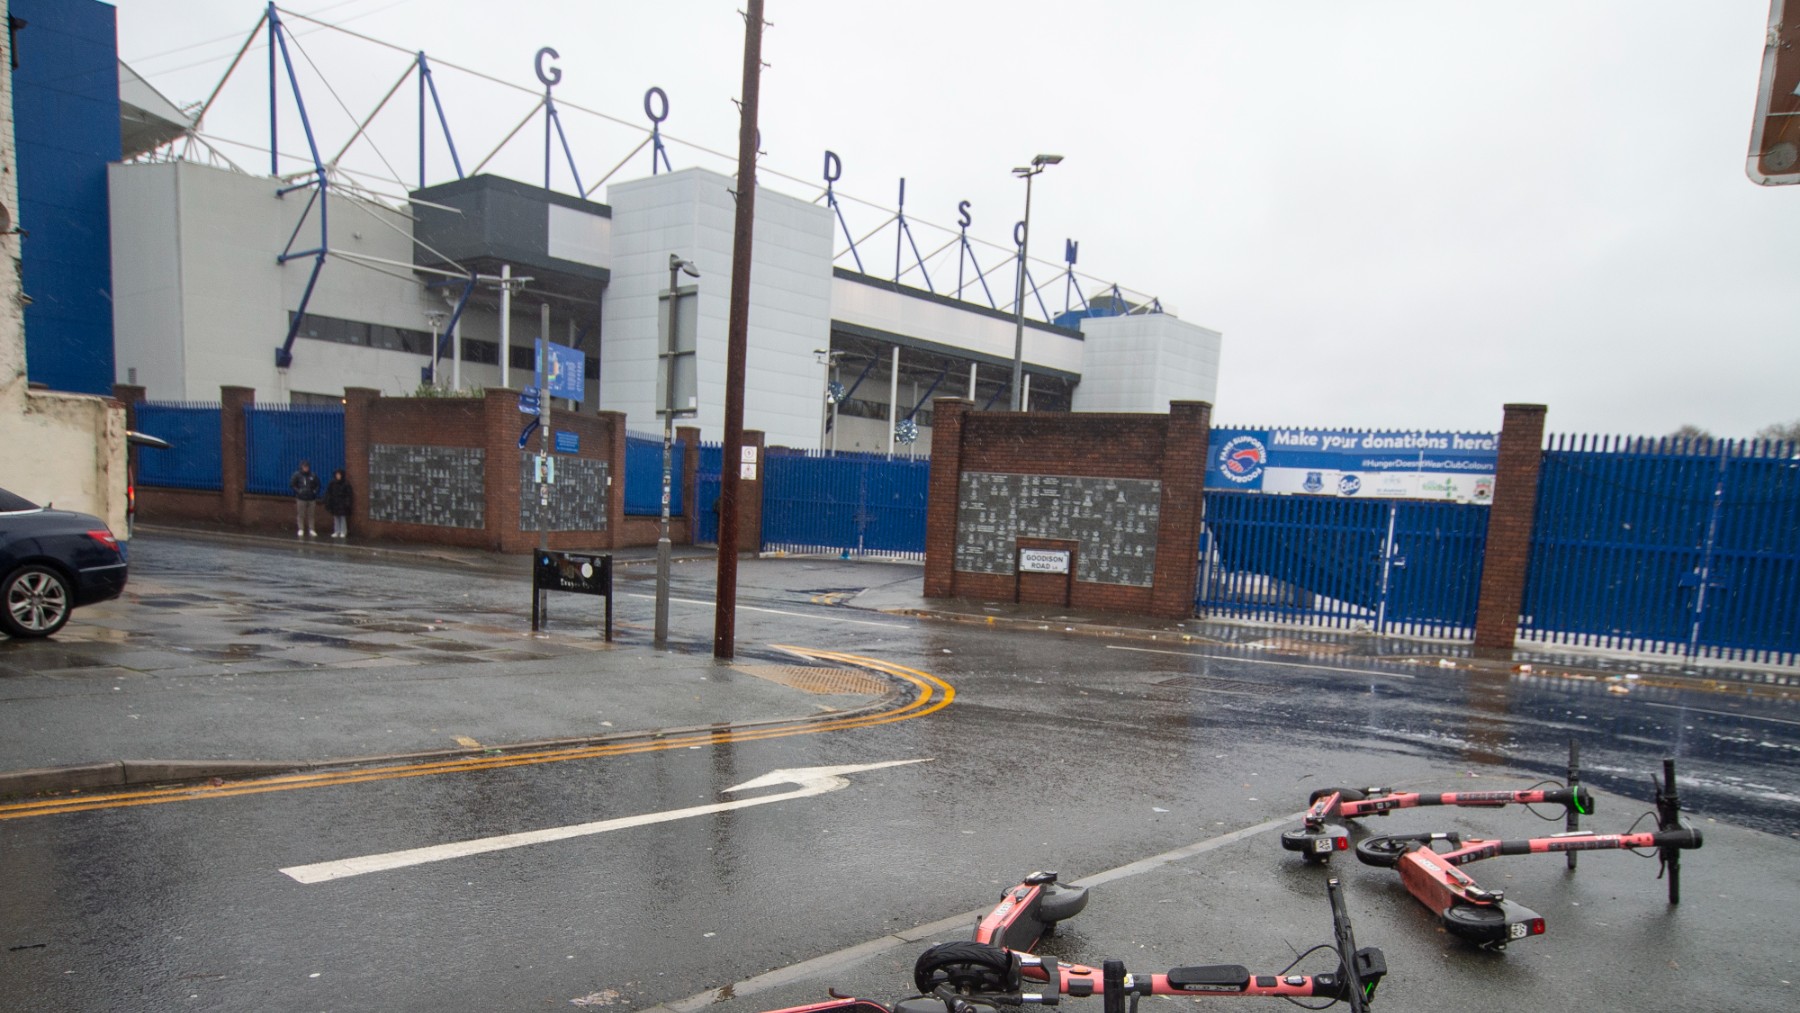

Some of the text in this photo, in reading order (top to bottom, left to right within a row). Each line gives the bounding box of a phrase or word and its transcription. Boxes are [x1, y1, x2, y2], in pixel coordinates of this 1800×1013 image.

[534, 46, 1079, 265] GODISON
[1220, 435, 1267, 464] FANS SUPPORTING
[1273, 429, 1500, 451] Make your donations here!
[1220, 464, 1262, 483] FOODBANKS
